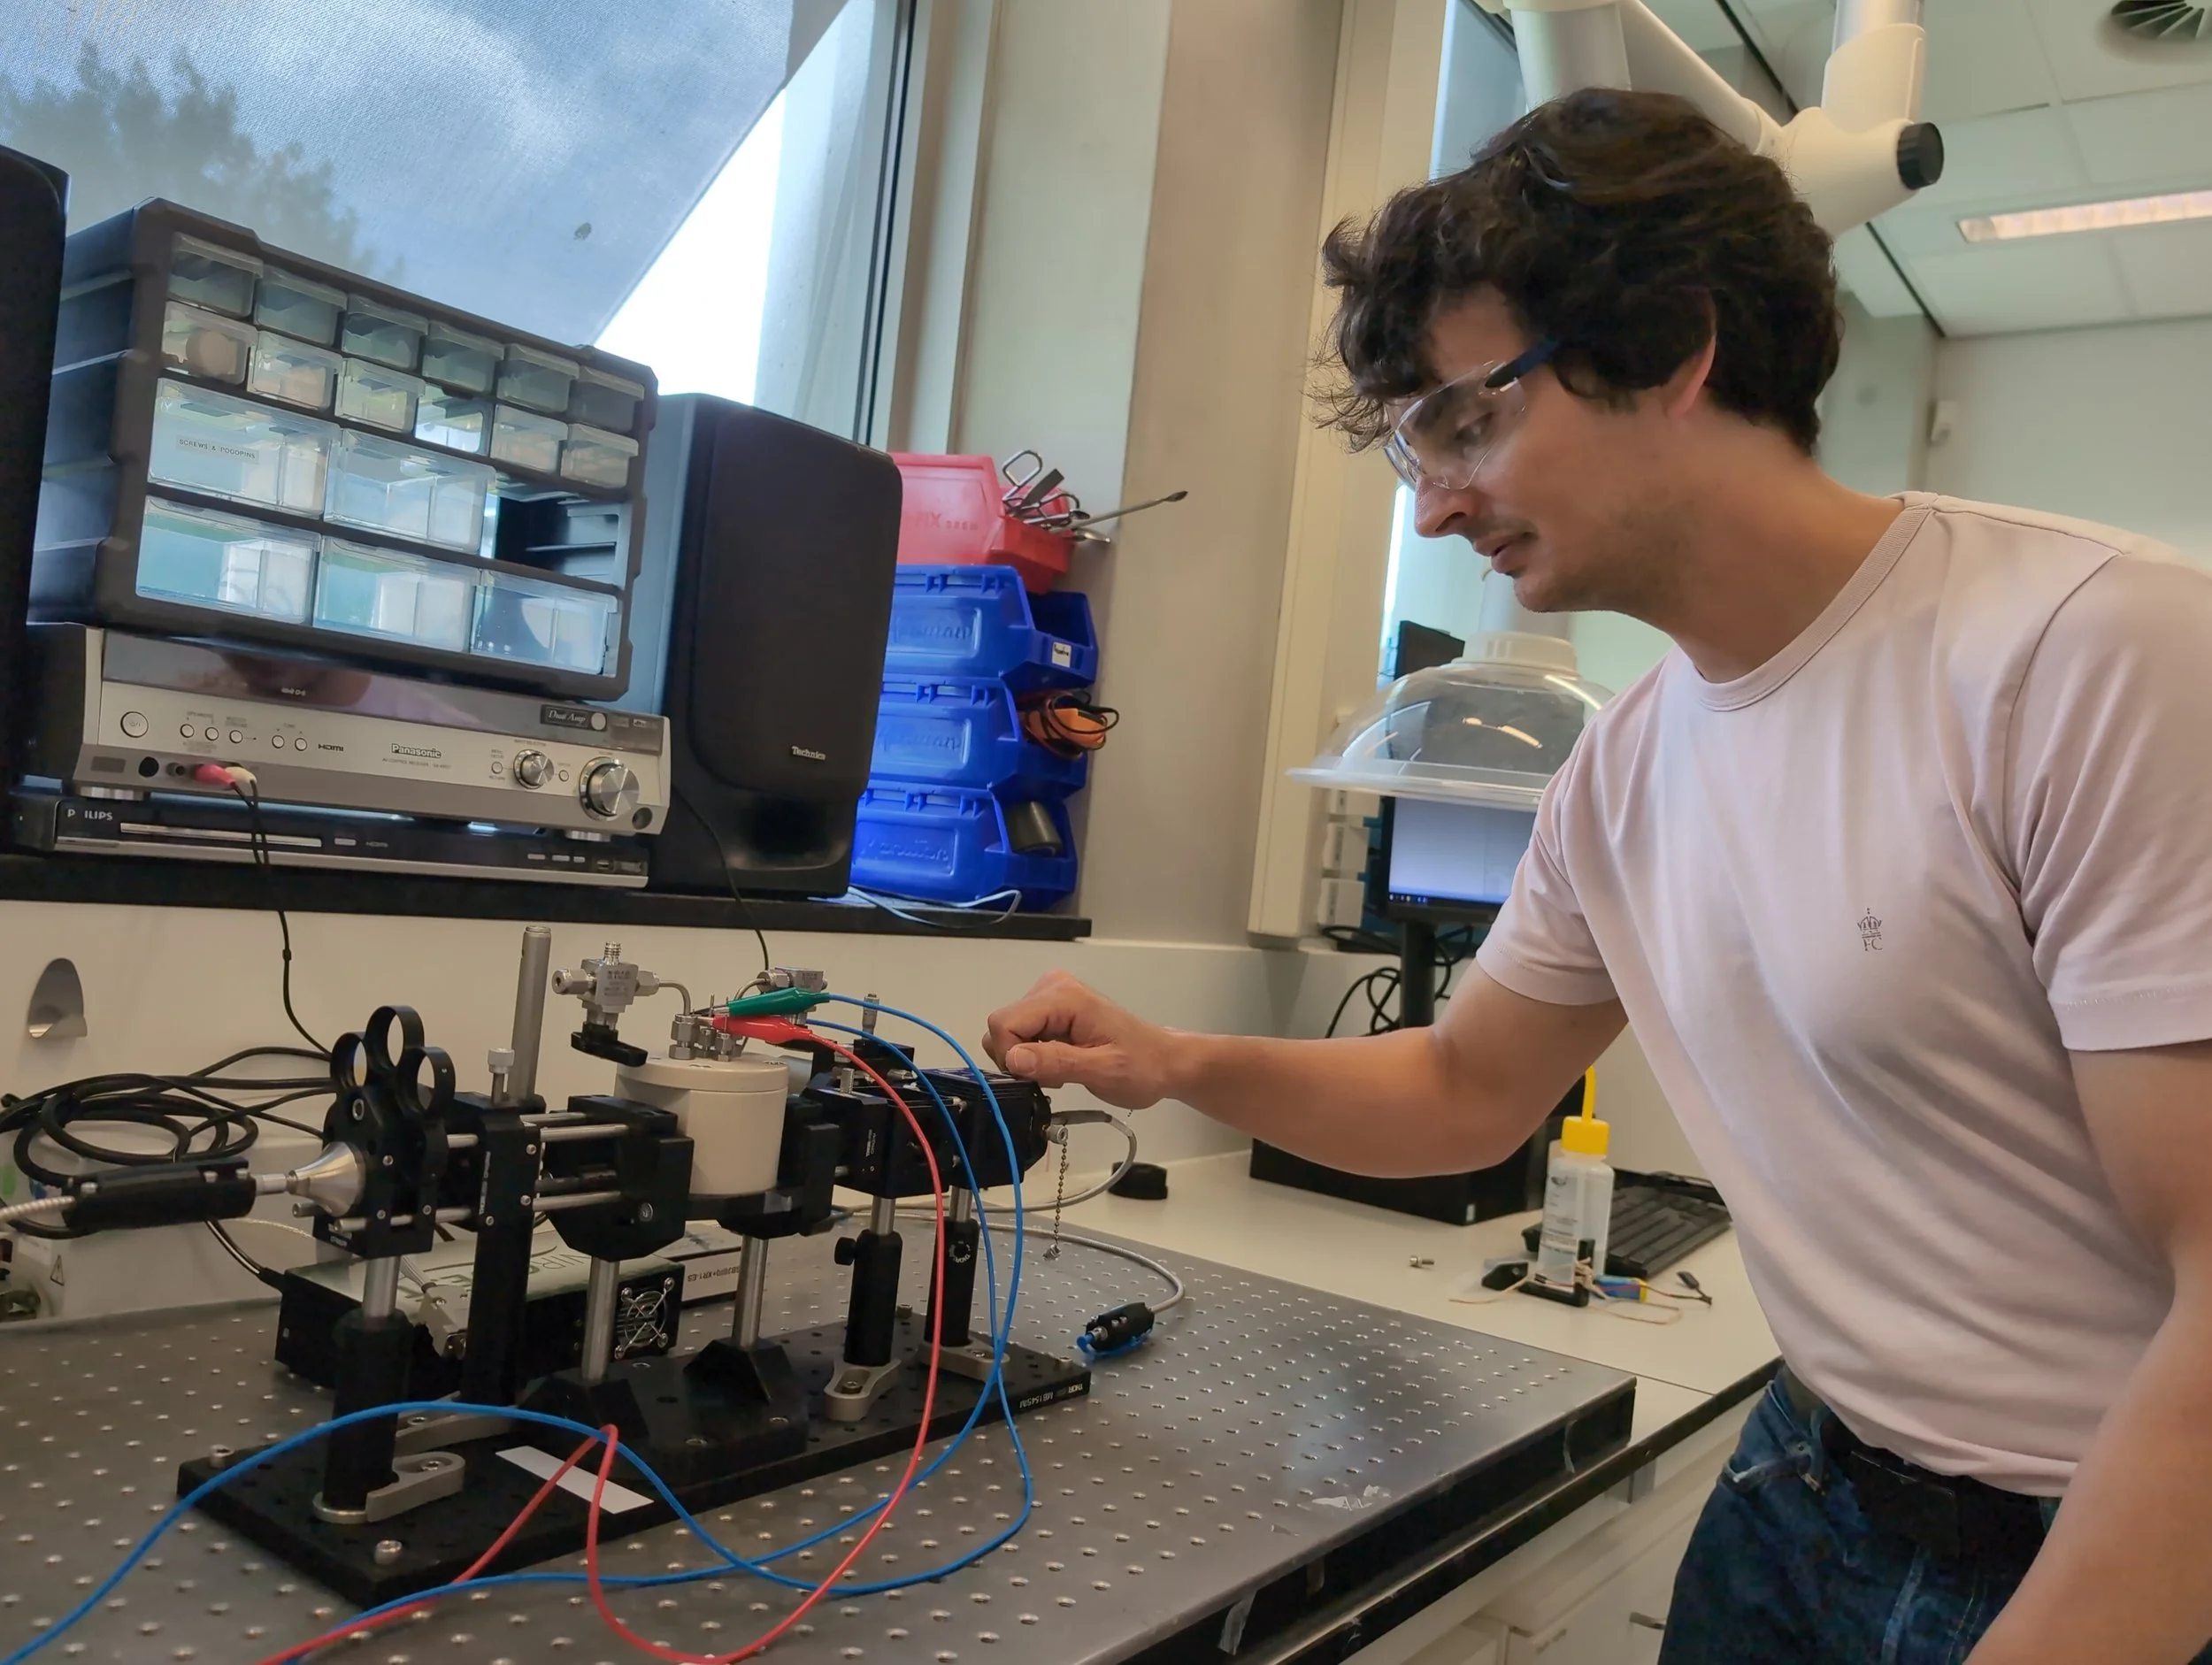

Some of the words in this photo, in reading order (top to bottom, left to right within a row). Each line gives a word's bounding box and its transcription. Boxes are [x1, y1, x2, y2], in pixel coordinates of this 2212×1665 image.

[179, 439, 208, 449] SCREWS
[220, 447, 256, 459] POGOPINS
[318, 743, 344, 752] HDMI
[391, 743, 442, 758] Panasonic
[791, 746, 826, 761] Technics
[66, 808, 113, 821] PILIPS
